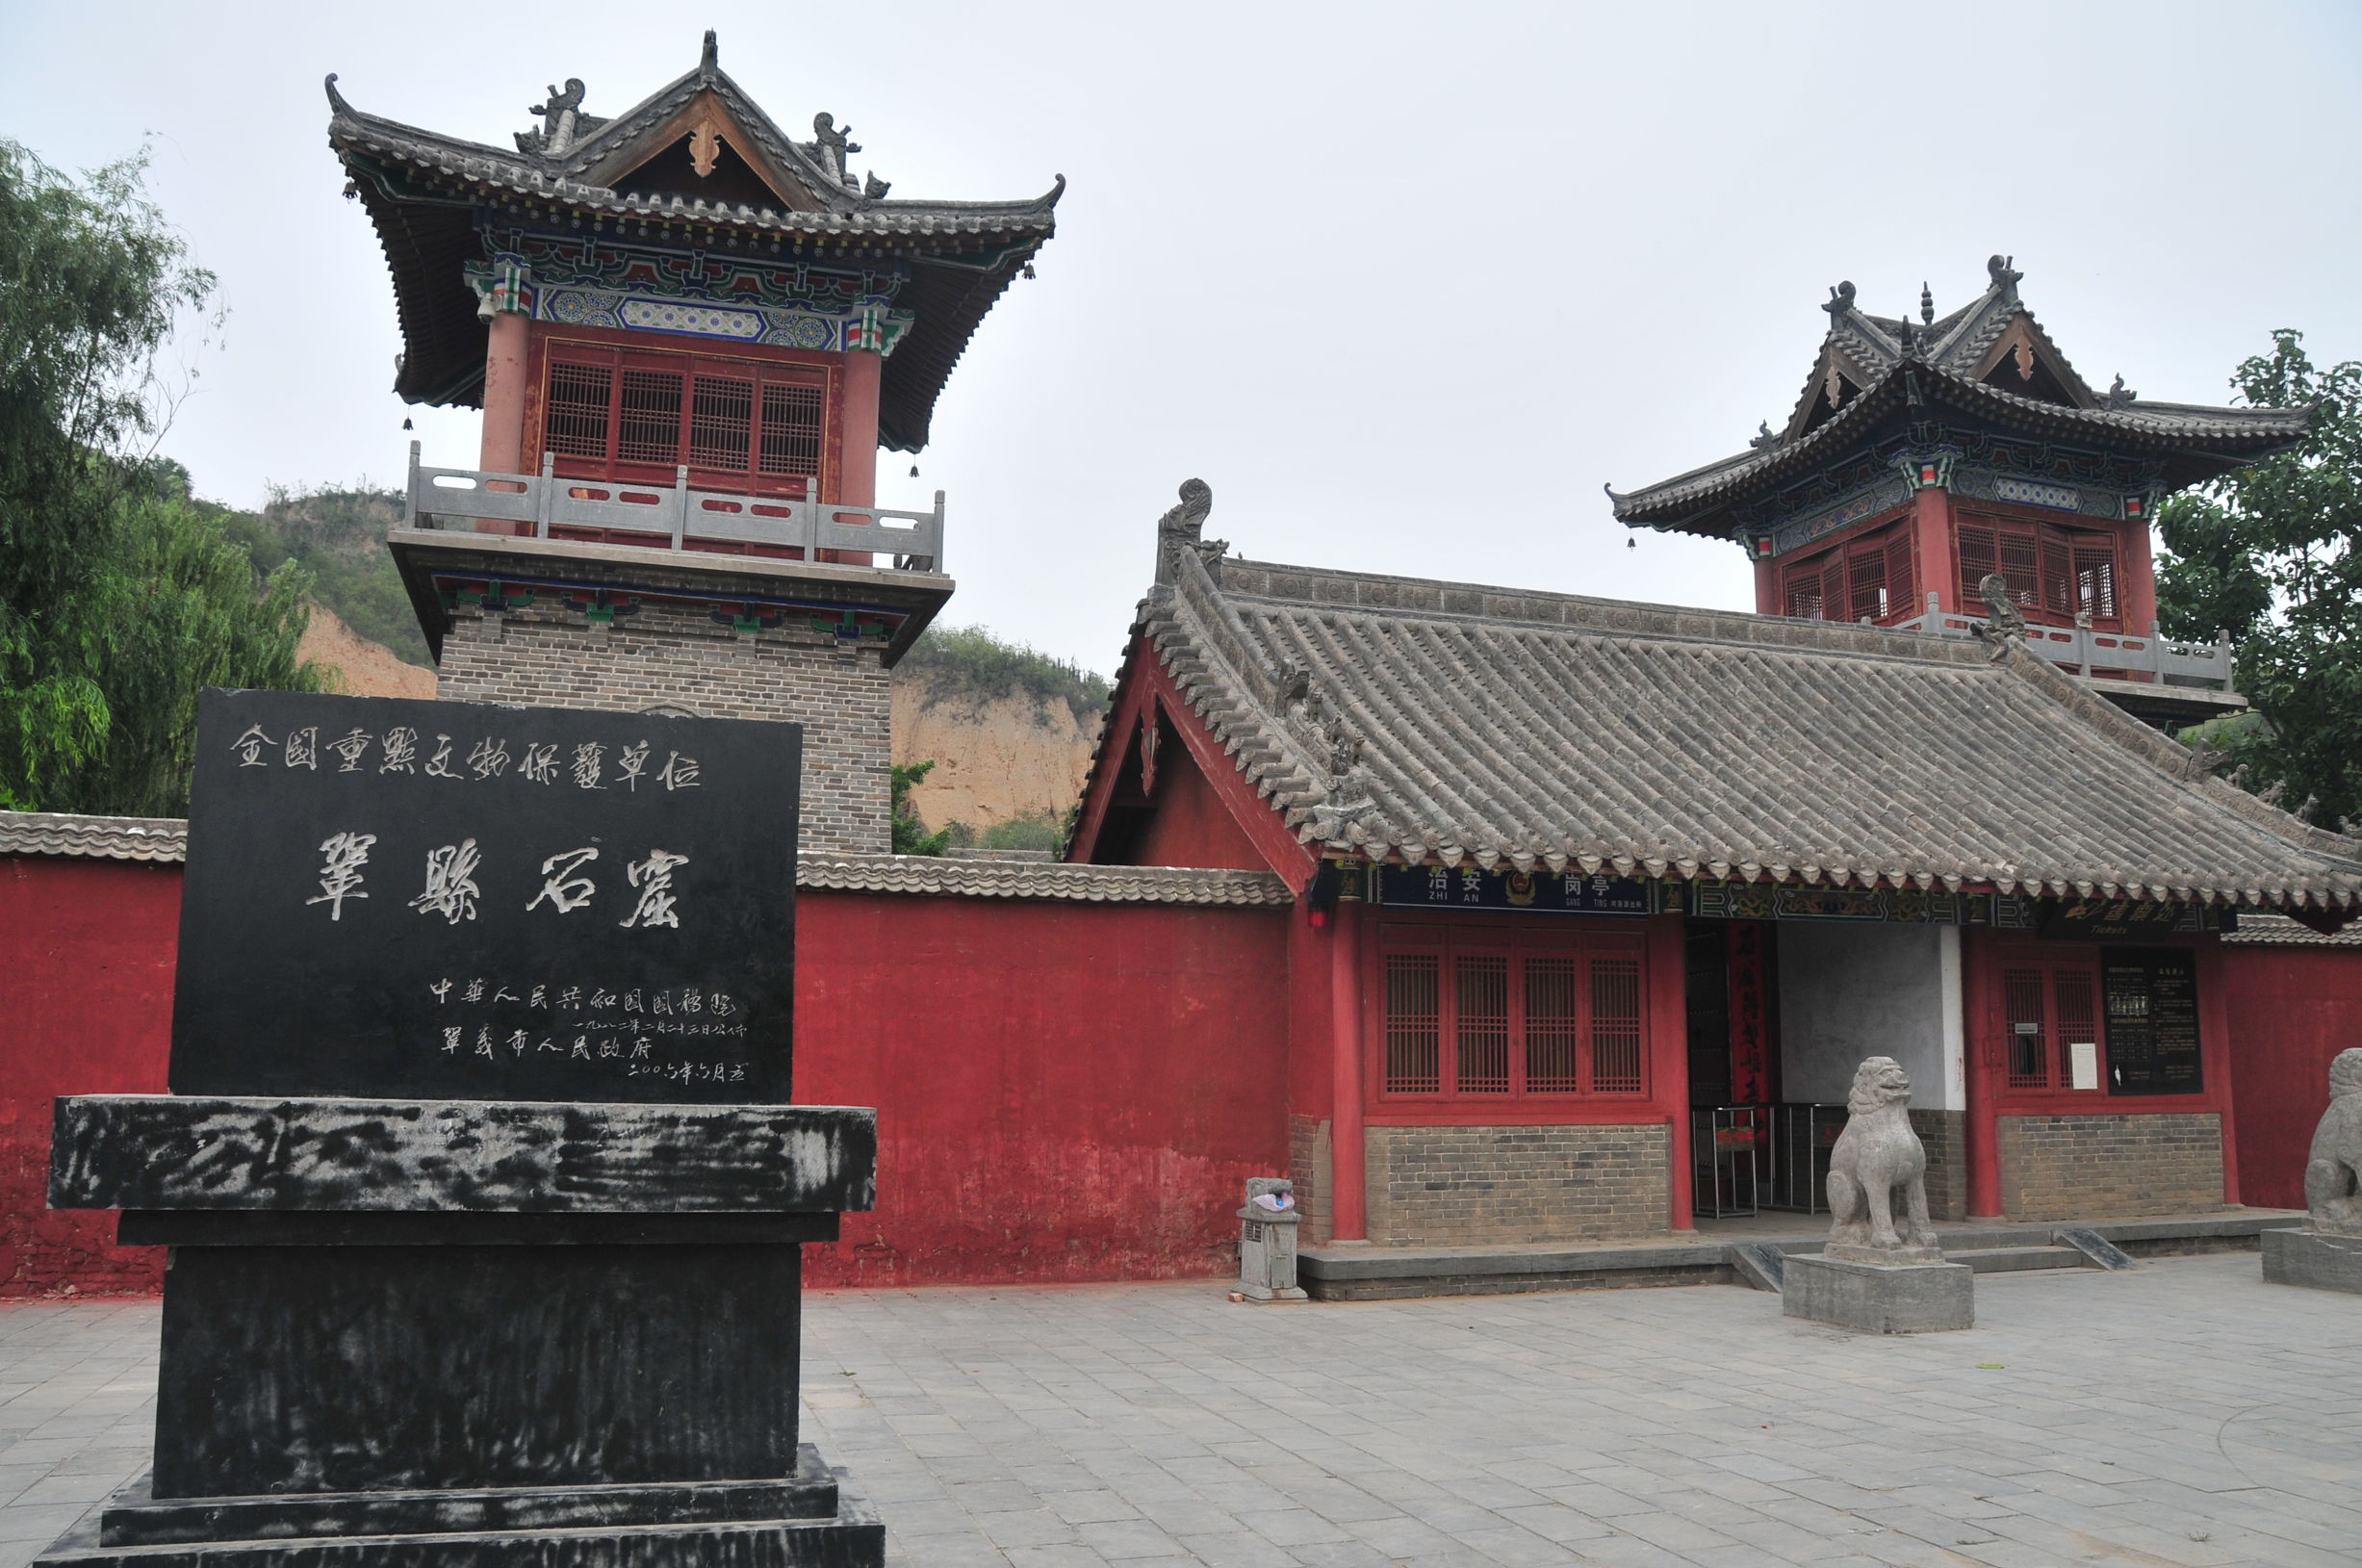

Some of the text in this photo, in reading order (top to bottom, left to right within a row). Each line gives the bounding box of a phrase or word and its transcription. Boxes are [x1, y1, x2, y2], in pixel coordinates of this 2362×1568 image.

[1428, 869, 1610, 897] 治安 岗亭
[1428, 891, 1449, 902] ZHI
[1463, 893, 1479, 904] AN
[2090, 924, 2128, 935] Tickets
